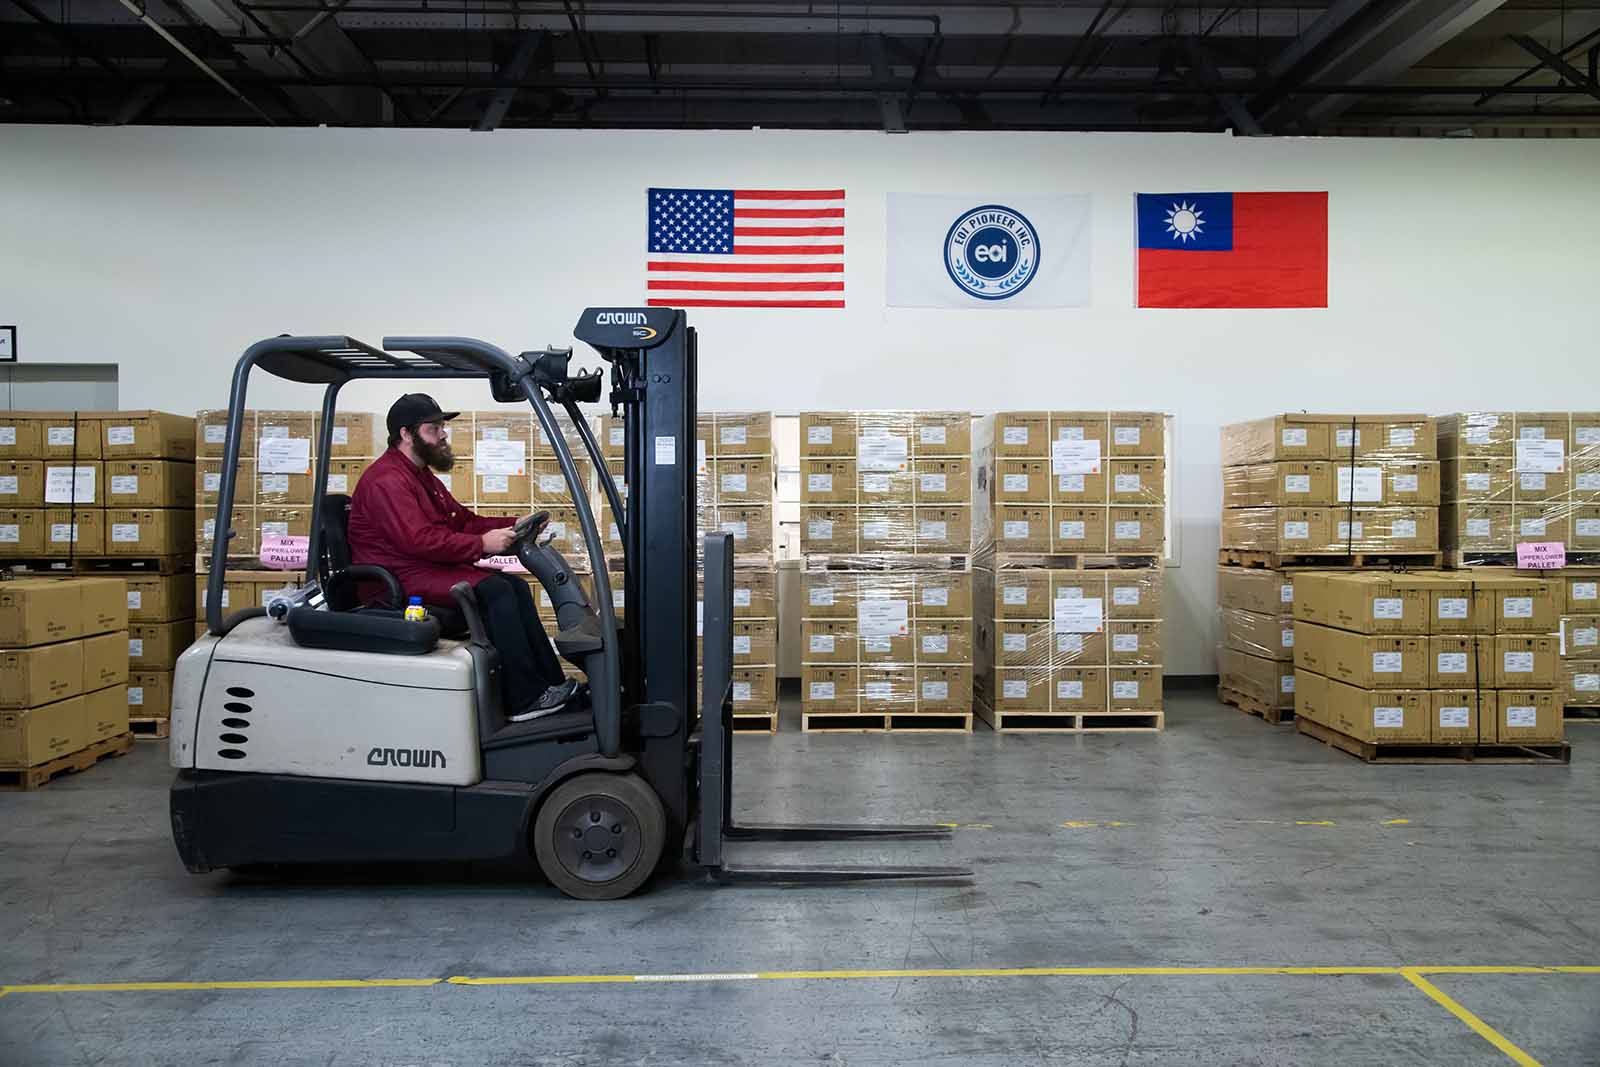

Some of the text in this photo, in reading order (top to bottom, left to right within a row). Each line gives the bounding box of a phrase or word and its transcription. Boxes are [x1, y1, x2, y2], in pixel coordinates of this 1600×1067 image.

[954, 227, 969, 245] EOI
[969, 213, 1016, 229] PIONEER
[974, 239, 1007, 263] eoi
[596, 312, 648, 325] CROWN
[270, 555, 301, 563] PALLET
[367, 747, 447, 769] CROWN
